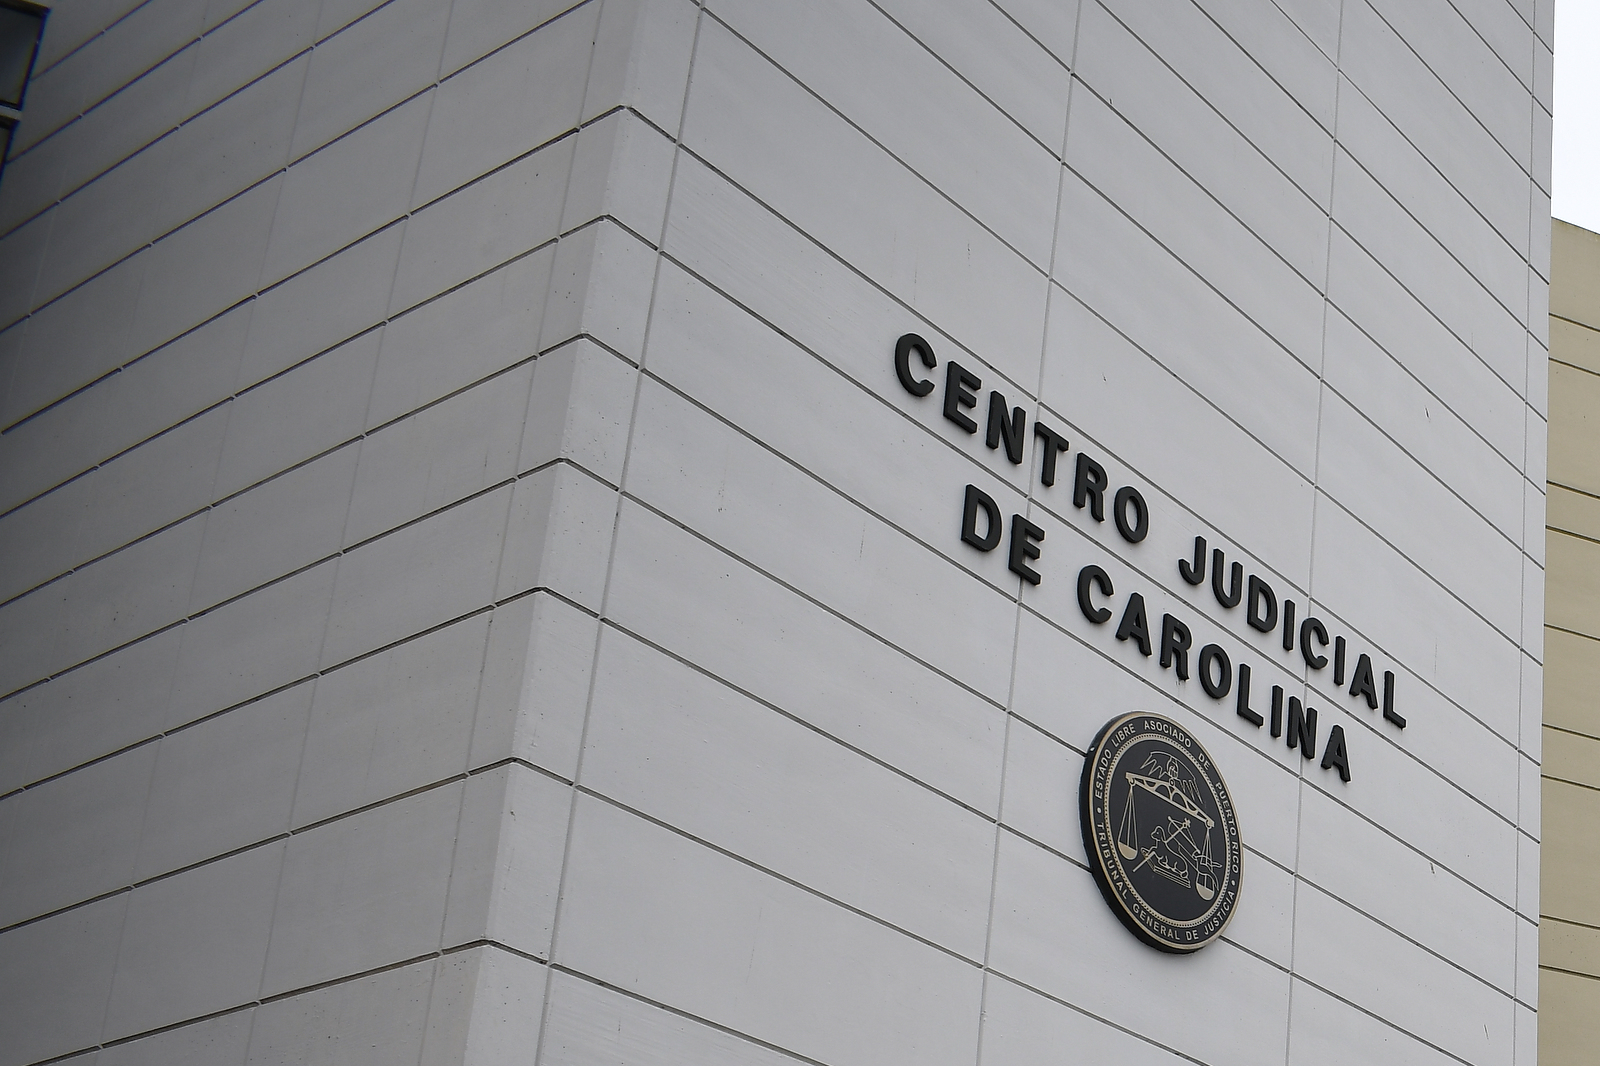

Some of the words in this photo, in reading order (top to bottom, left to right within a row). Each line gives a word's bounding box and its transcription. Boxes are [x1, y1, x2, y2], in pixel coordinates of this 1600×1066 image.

[894, 332, 1149, 544] CENTRO
[1178, 536, 1407, 730] JUDICIAL
[961, 484, 1045, 586] DE
[1076, 564, 1352, 783] CAROLINA
[1095, 750, 1113, 800] ESTADO
[1112, 722, 1137, 747] LIBRE
[1144, 720, 1193, 748] ASOCIADO
[1198, 753, 1211, 771] DE
[1215, 781, 1237, 836] PUERTO
[1231, 840, 1240, 875] RICO
[1096, 821, 1130, 900] TRIBUNAL
[1132, 903, 1181, 941] GENERAL
[1185, 930, 1200, 942] DE
[1203, 890, 1236, 936] JUSTICIA
